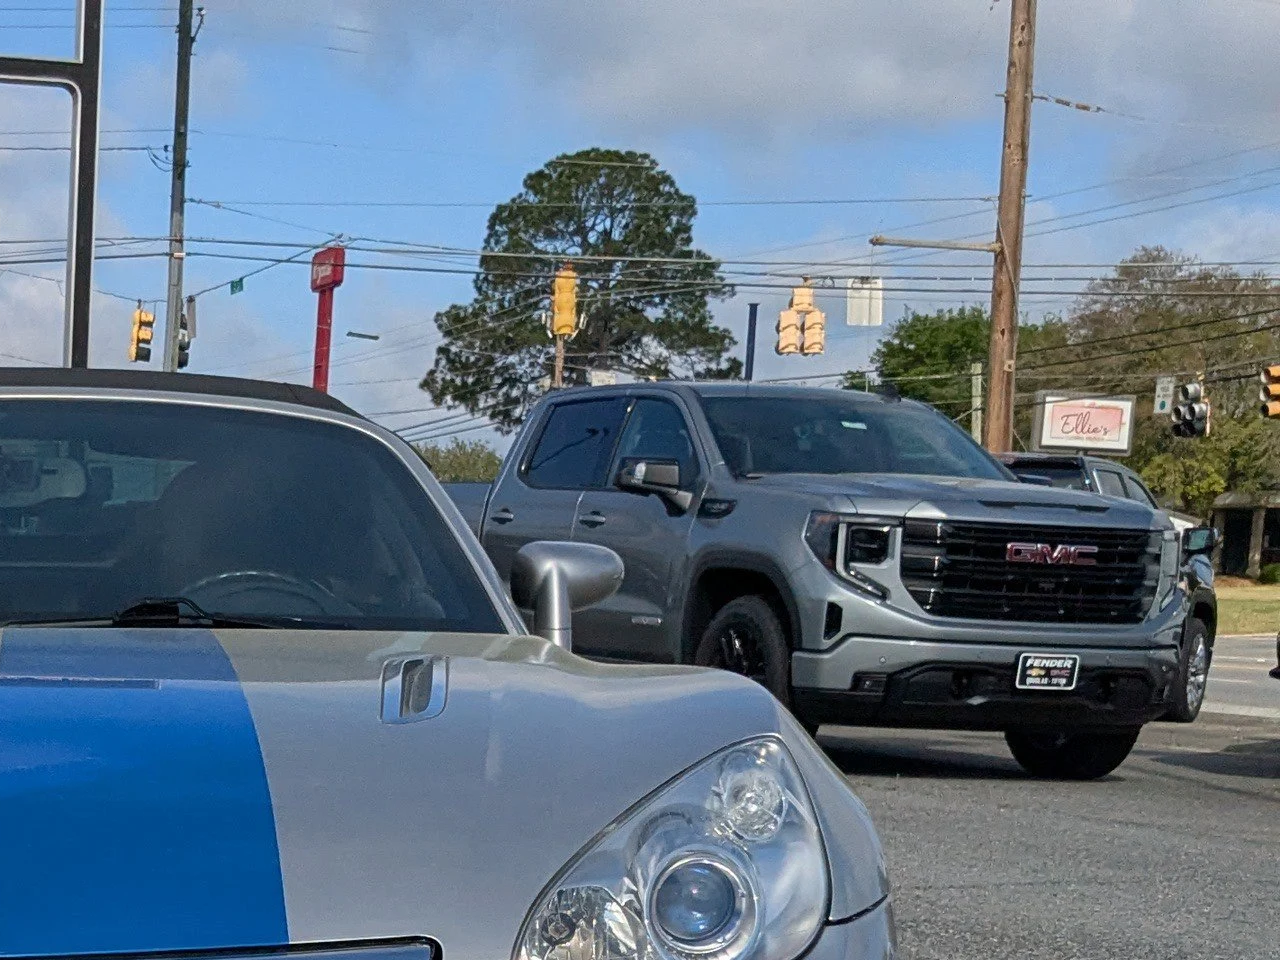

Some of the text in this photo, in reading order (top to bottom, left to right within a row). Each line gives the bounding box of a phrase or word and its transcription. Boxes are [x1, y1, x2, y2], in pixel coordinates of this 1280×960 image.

[1061, 411, 1110, 436] Ellie's
[1005, 542, 1099, 566] GMC
[1025, 658, 1074, 669] FENDER
